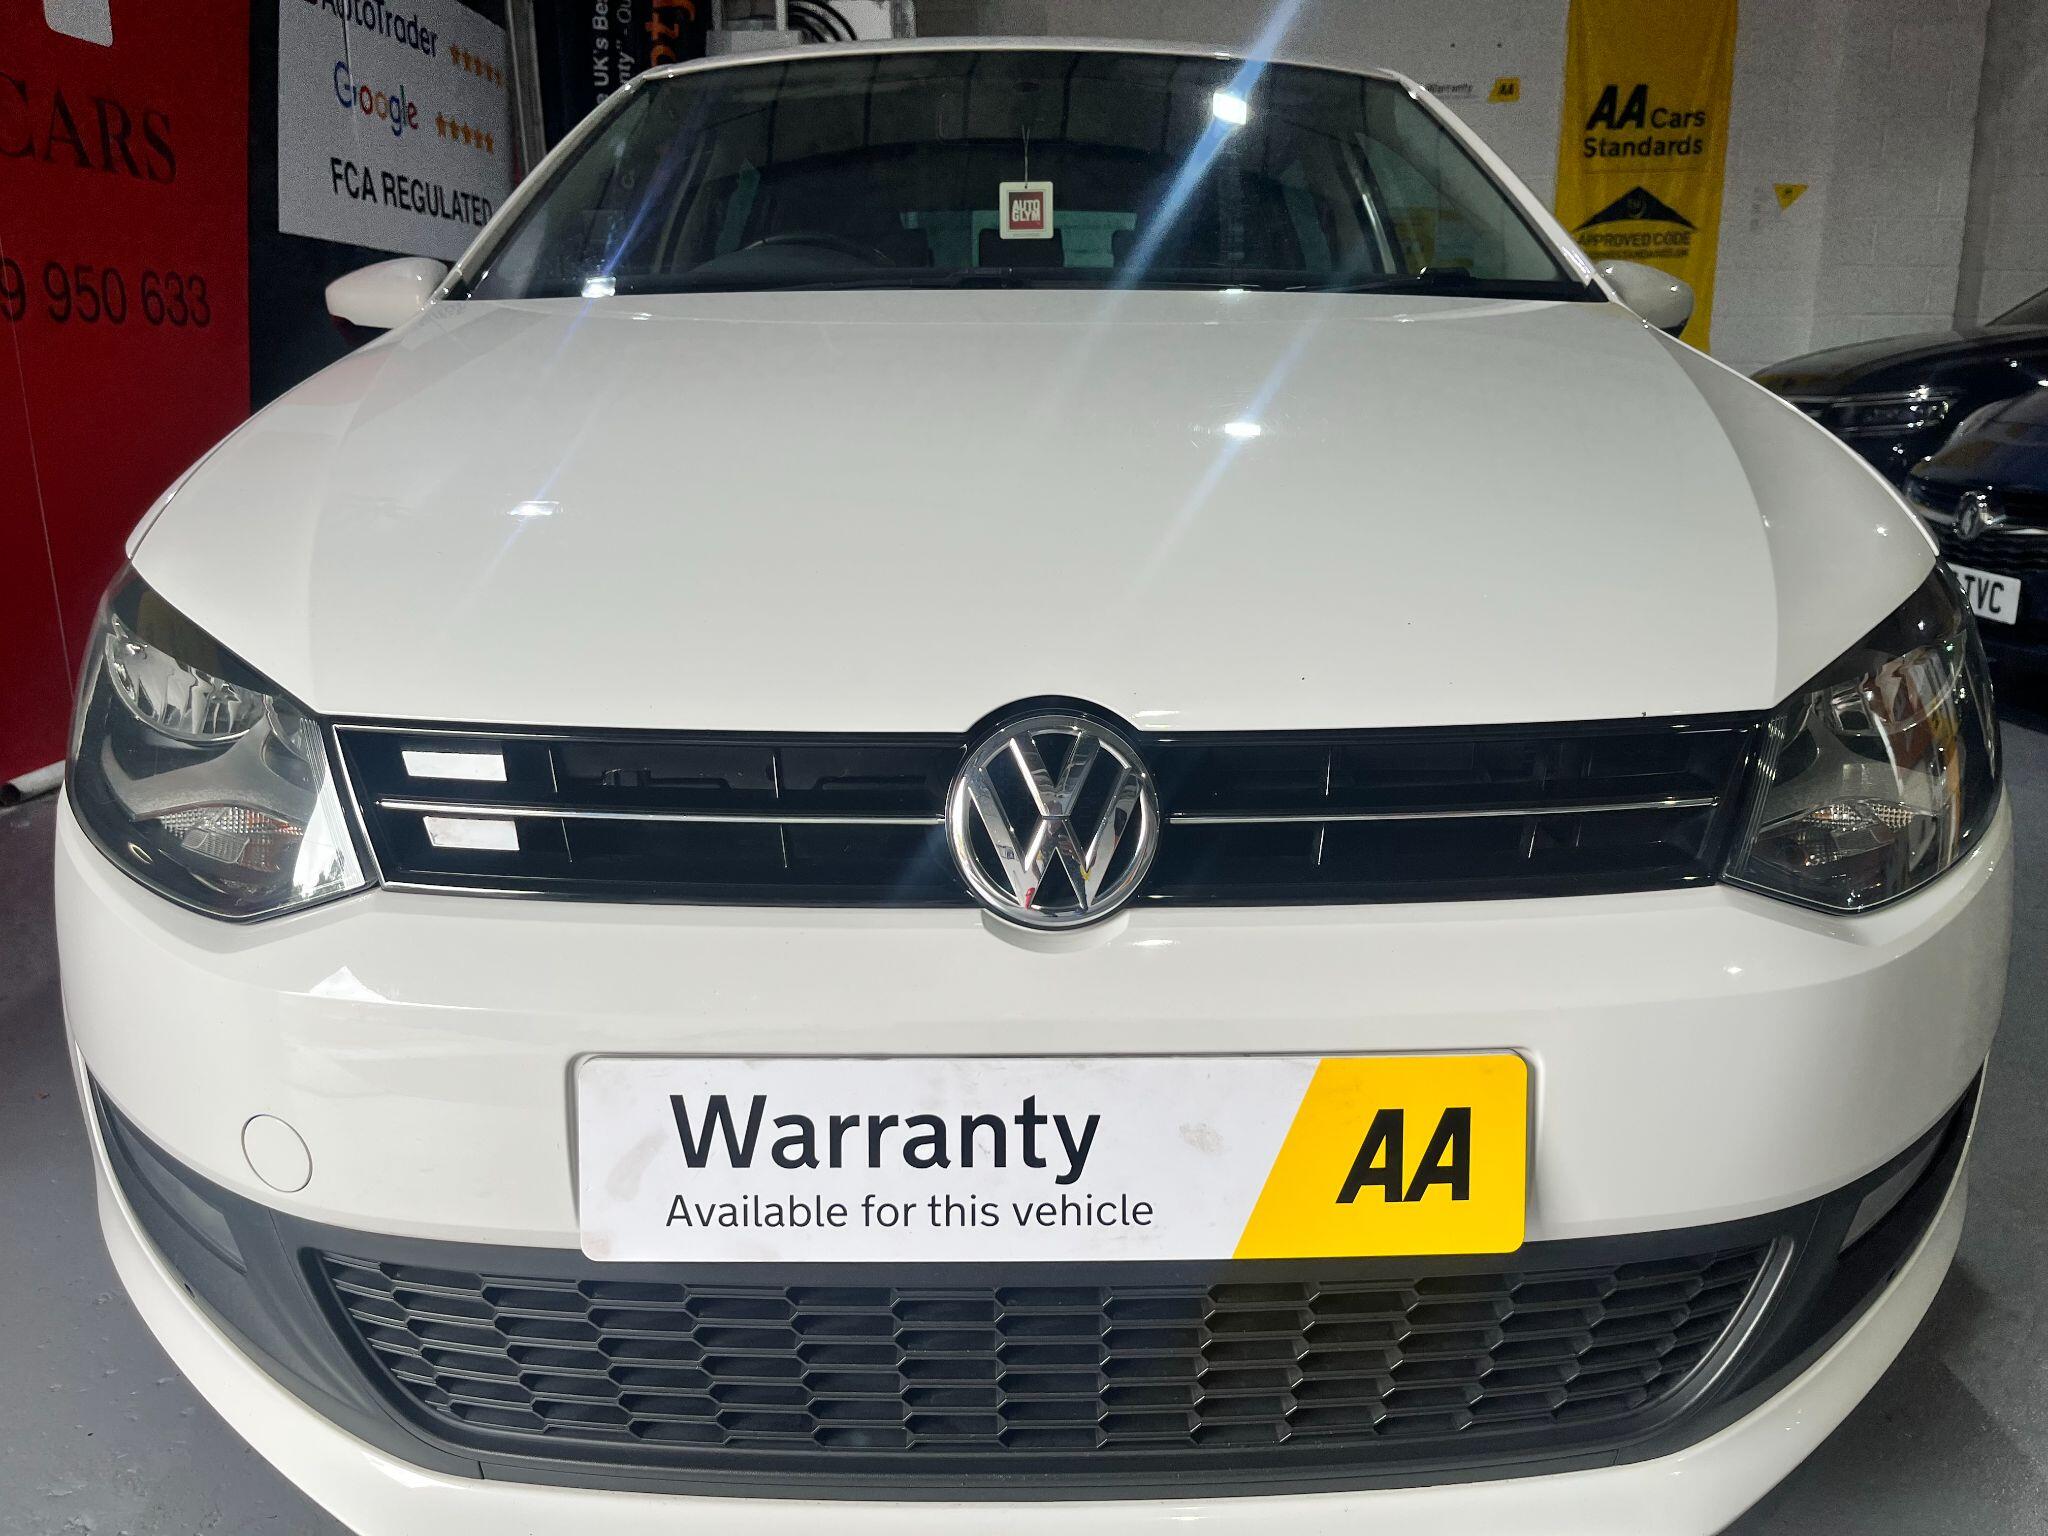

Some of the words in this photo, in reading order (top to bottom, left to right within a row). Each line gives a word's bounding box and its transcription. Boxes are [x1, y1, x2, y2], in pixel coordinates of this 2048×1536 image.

[592, 0, 610, 30] Be
[592, 37, 610, 87] UK's
[333, 61, 419, 137] Google
[1585, 83, 1649, 130] AA
[1651, 107, 1707, 129] Cars
[1583, 135, 1704, 159] Standards
[330, 157, 378, 203] FCA
[380, 171, 494, 227] REGULATED
[1012, 199, 1041, 212] AUTO
[1012, 210, 1041, 222] GLYM
[43, 261, 128, 325] 950
[140, 268, 212, 328] 633
[1953, 570, 2005, 614] TVC
[669, 1094, 1101, 1186] Warranty
[1335, 1106, 1471, 1204] AA
[665, 1194, 848, 1228] Available
[861, 1194, 917, 1227] for
[927, 1194, 1000, 1227] this
[1012, 1193, 1154, 1227] vehicle
